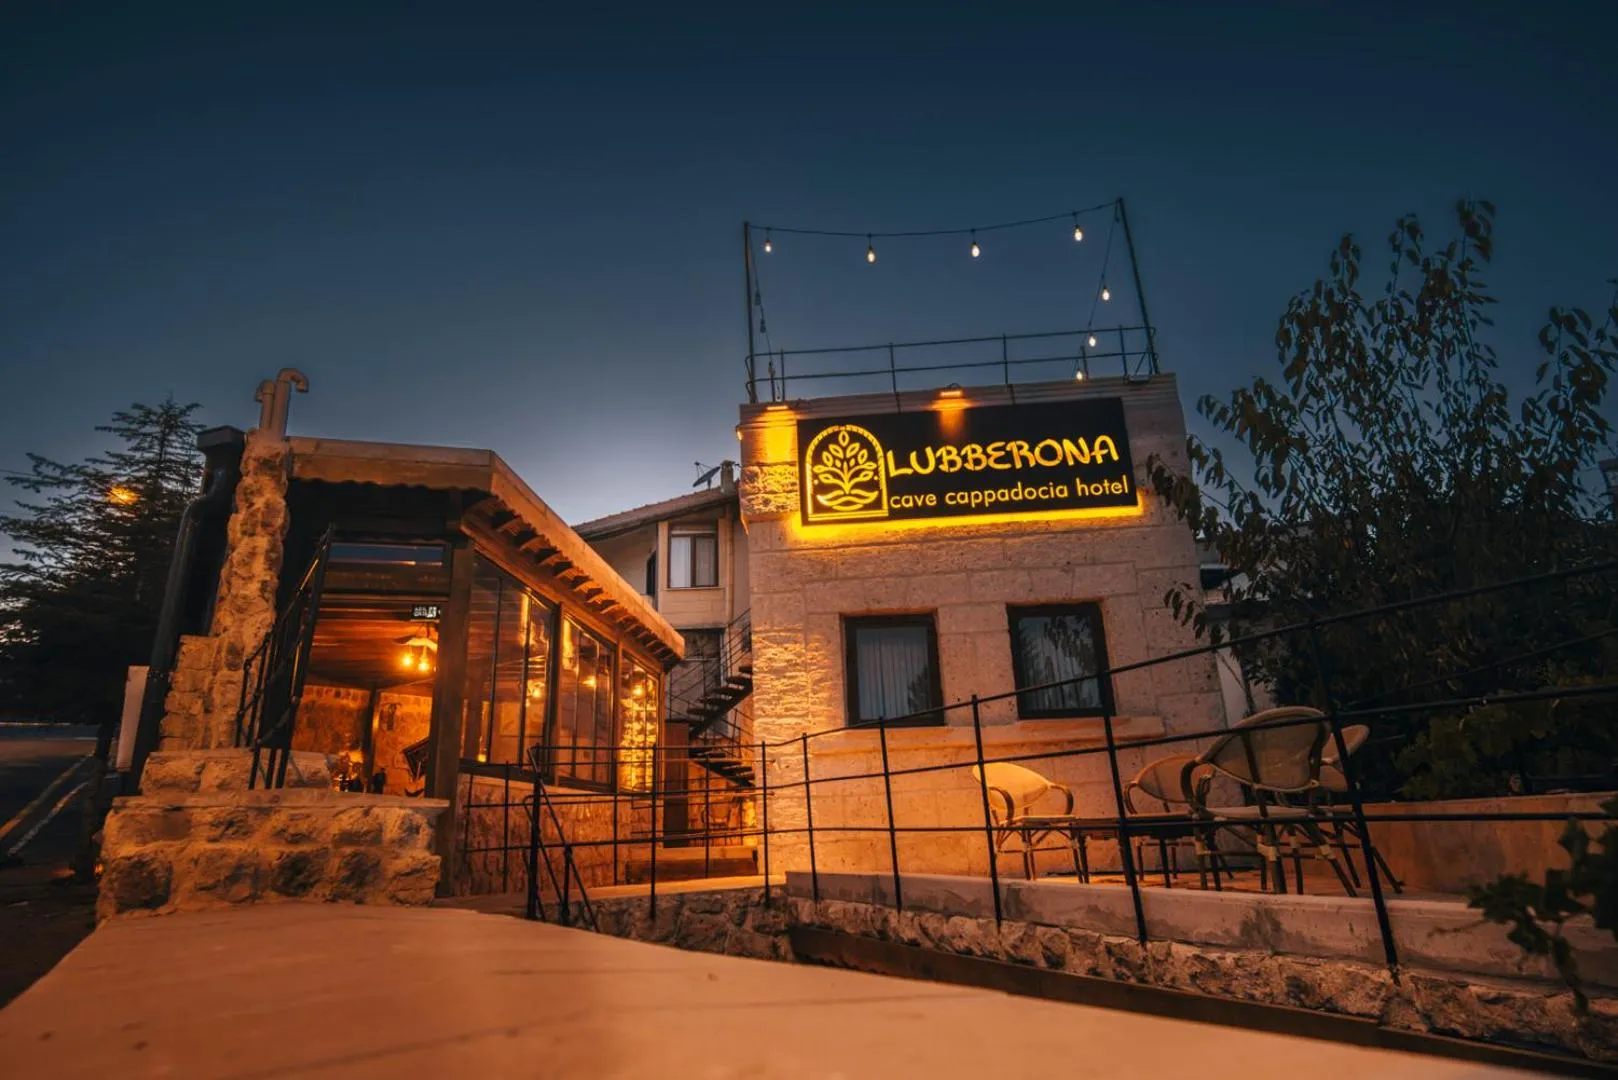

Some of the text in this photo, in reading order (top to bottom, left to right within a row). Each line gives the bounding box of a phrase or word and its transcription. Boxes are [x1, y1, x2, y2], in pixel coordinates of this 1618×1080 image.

[886, 434, 1120, 478] LUBBERONA
[890, 475, 1129, 509] cave cappadocia hotel
